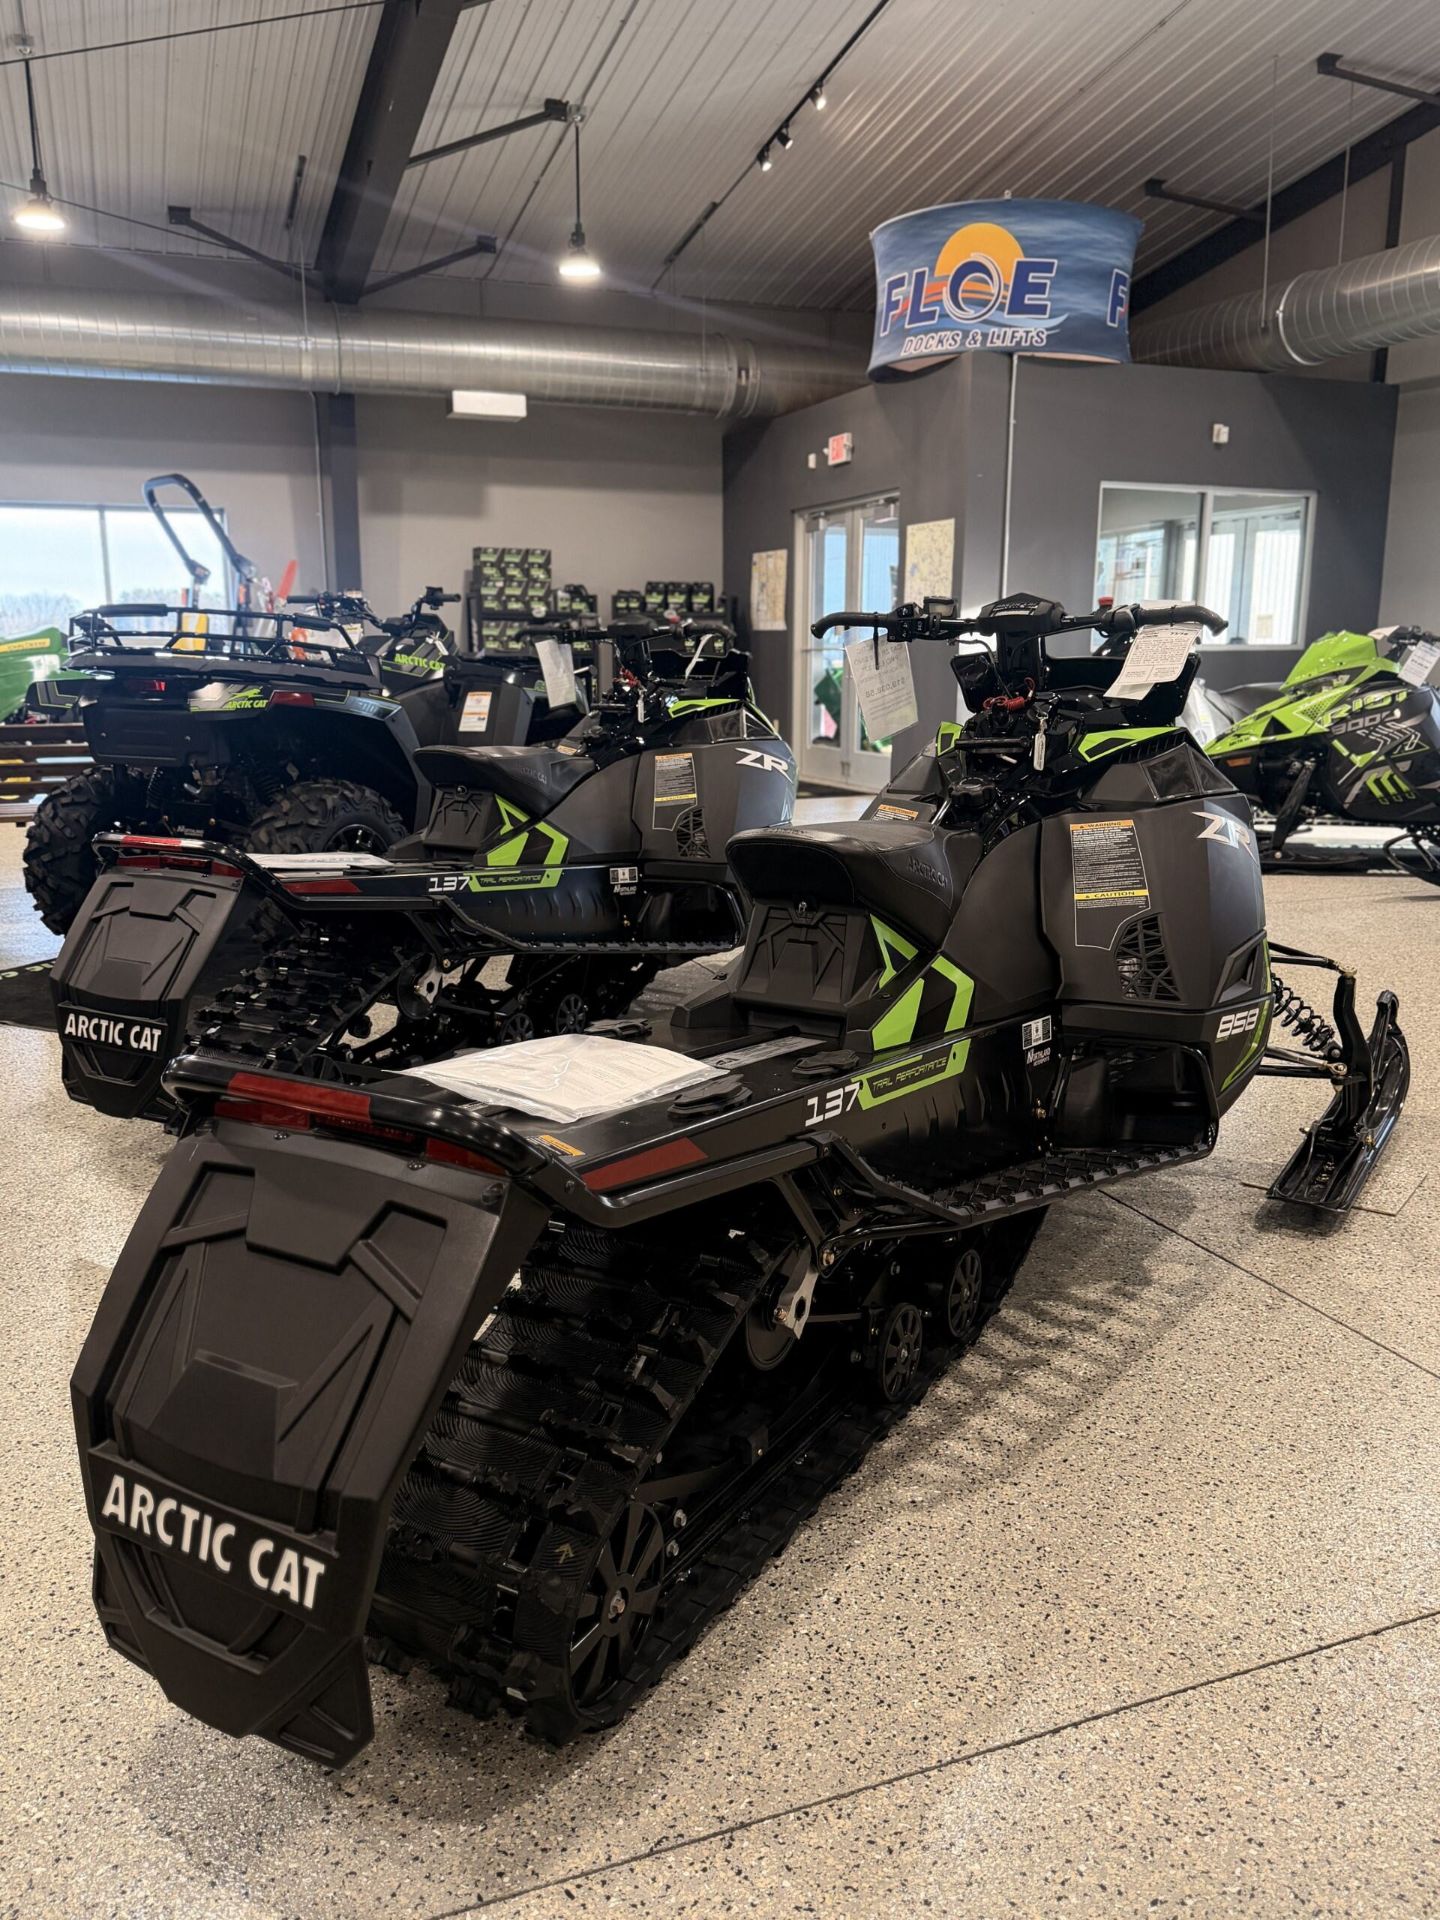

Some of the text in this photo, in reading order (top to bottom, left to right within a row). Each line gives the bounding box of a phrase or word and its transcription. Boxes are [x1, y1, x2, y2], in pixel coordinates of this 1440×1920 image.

[880, 252, 1058, 337] FLOE
[900, 326, 1047, 356] DOCKS & LIFTS
[394, 653, 428, 668] ARCTIC
[228, 700, 269, 709] ARCTIC CAT
[735, 747, 794, 785] ZR
[1191, 811, 1259, 868] ZR
[428, 876, 471, 892] 137
[64, 1013, 162, 1052] ARCTIC CAT
[1216, 1008, 1260, 1039] 858
[805, 1082, 861, 1127] 137
[872, 1077, 893, 1092] TRAIL
[101, 1473, 326, 1610] ARCTIC CAT
